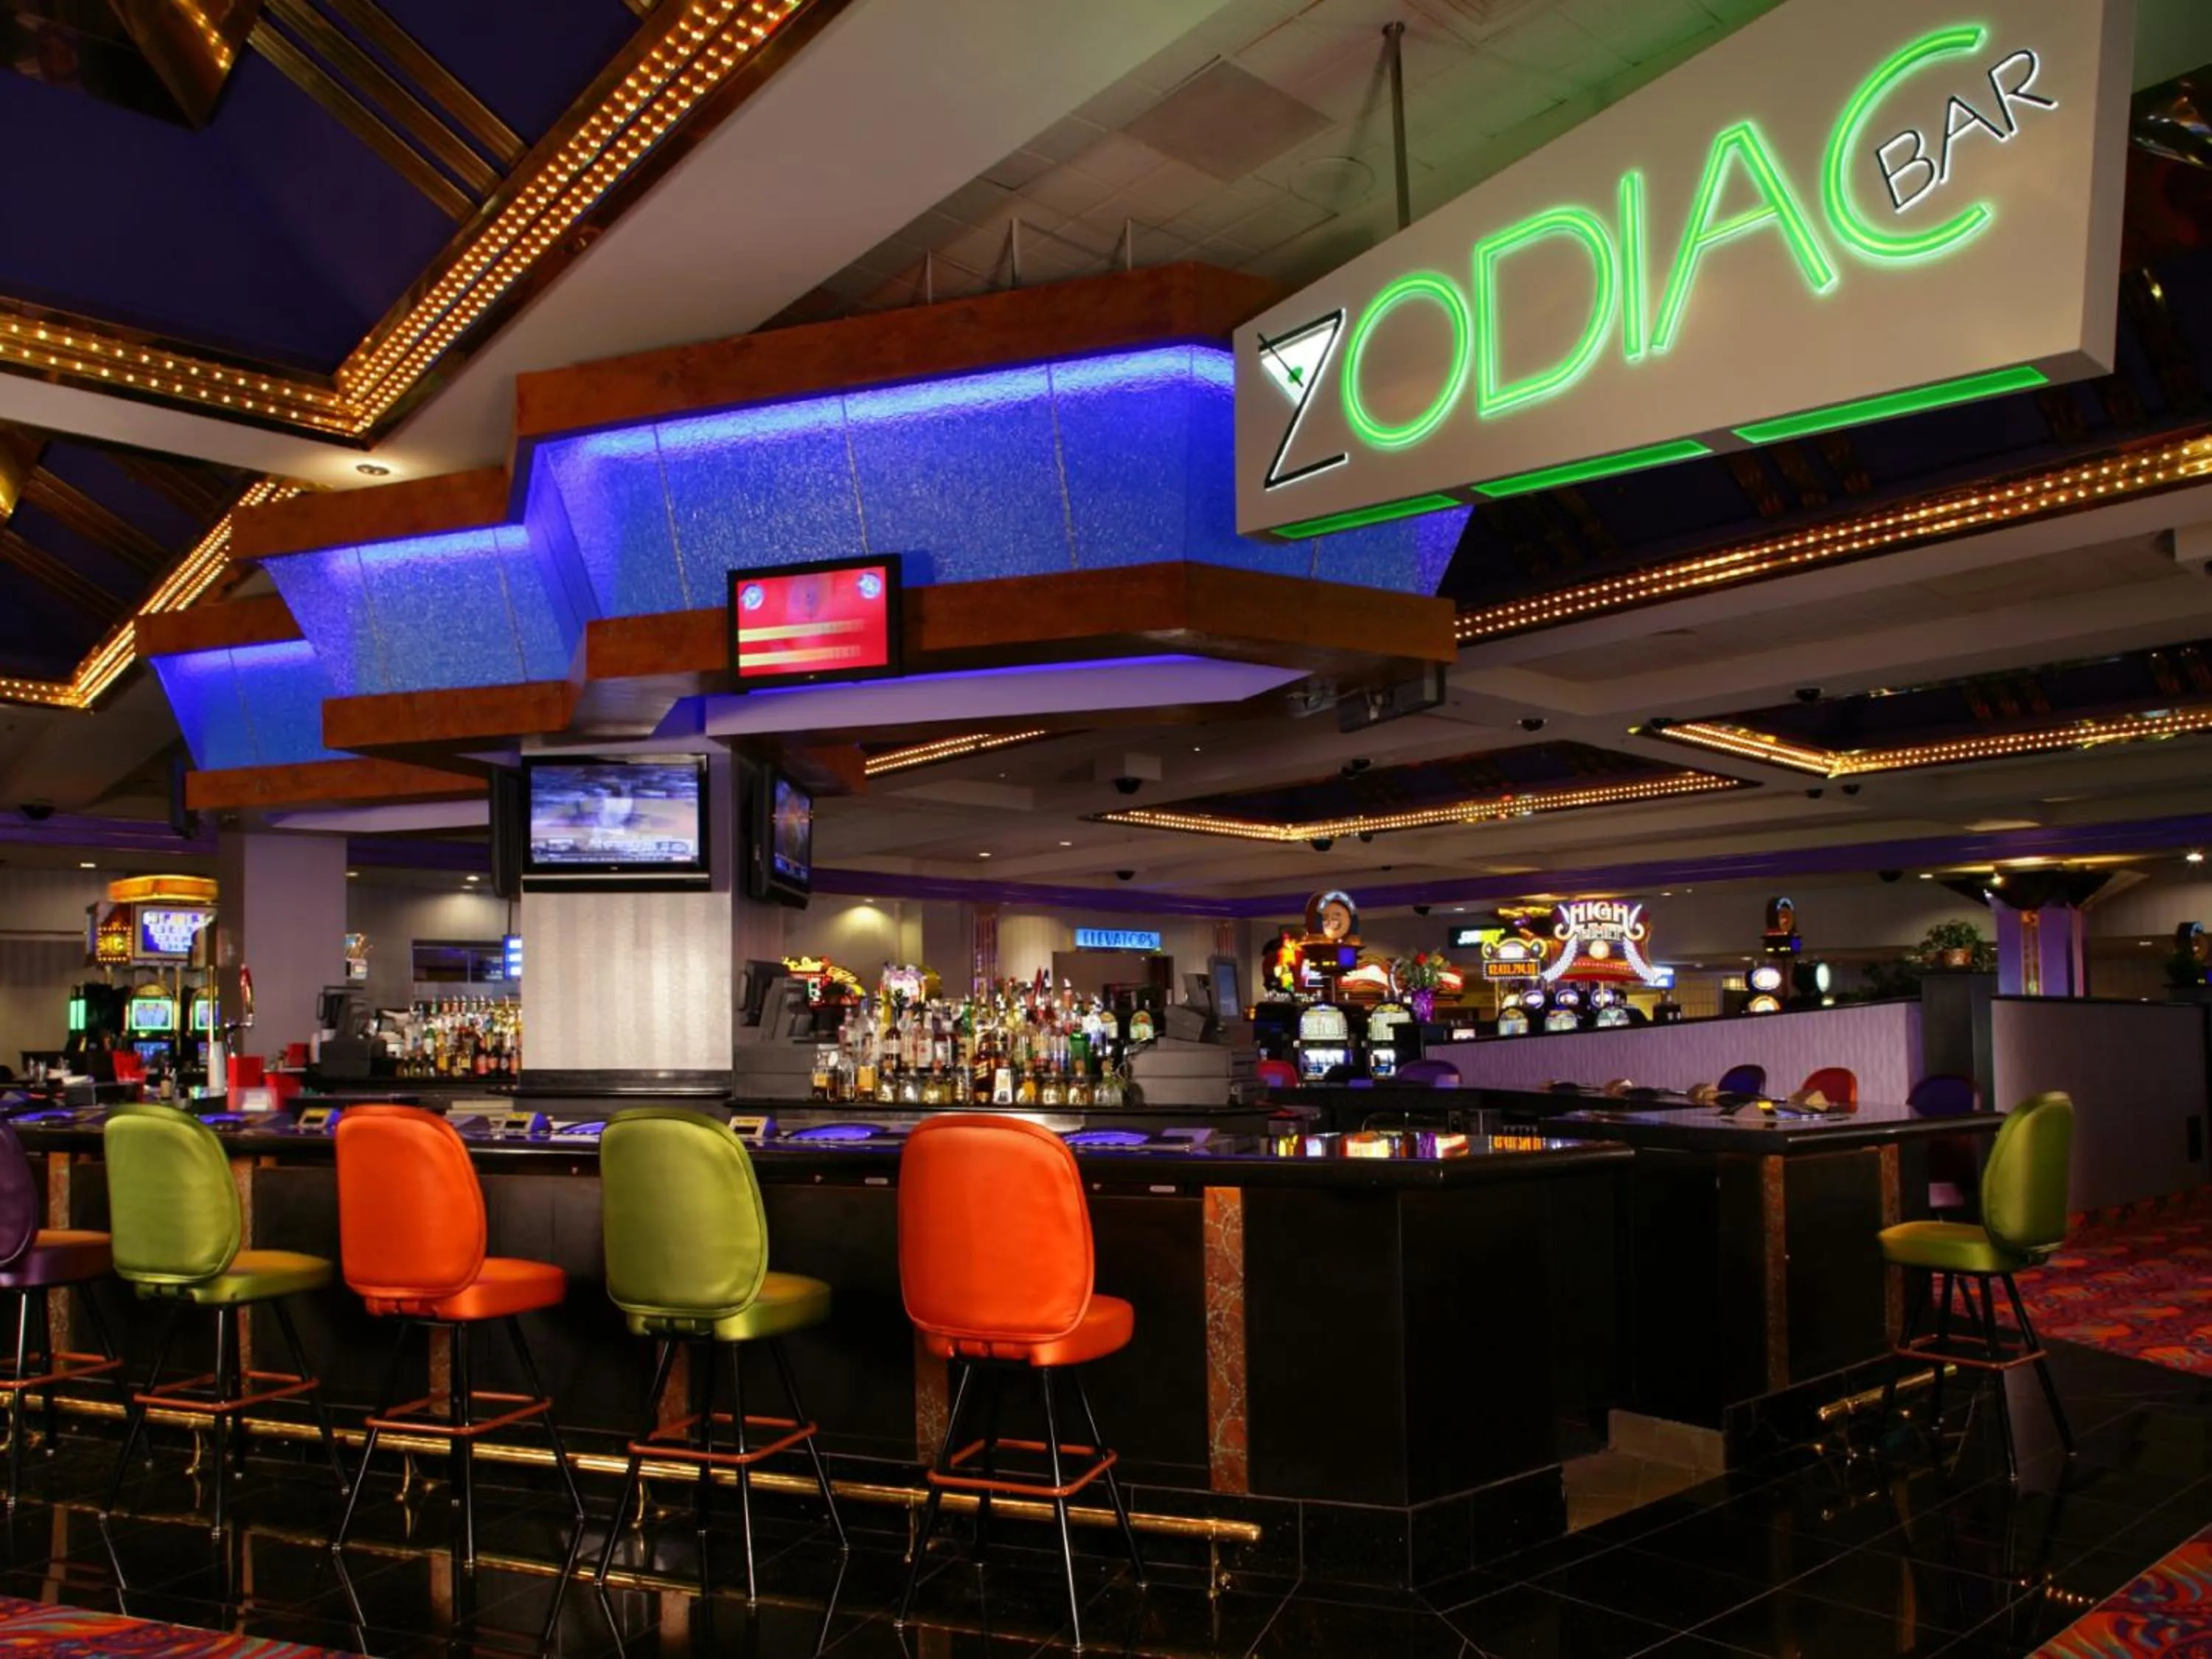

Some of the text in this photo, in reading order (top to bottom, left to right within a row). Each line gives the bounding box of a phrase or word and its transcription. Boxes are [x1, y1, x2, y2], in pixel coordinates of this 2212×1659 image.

[1877, 48, 2058, 212] BAR
[1258, 25, 1992, 490] ZODIAC
[1082, 930, 1155, 947] ELEVATORS
[1568, 900, 1630, 925] HIGH
